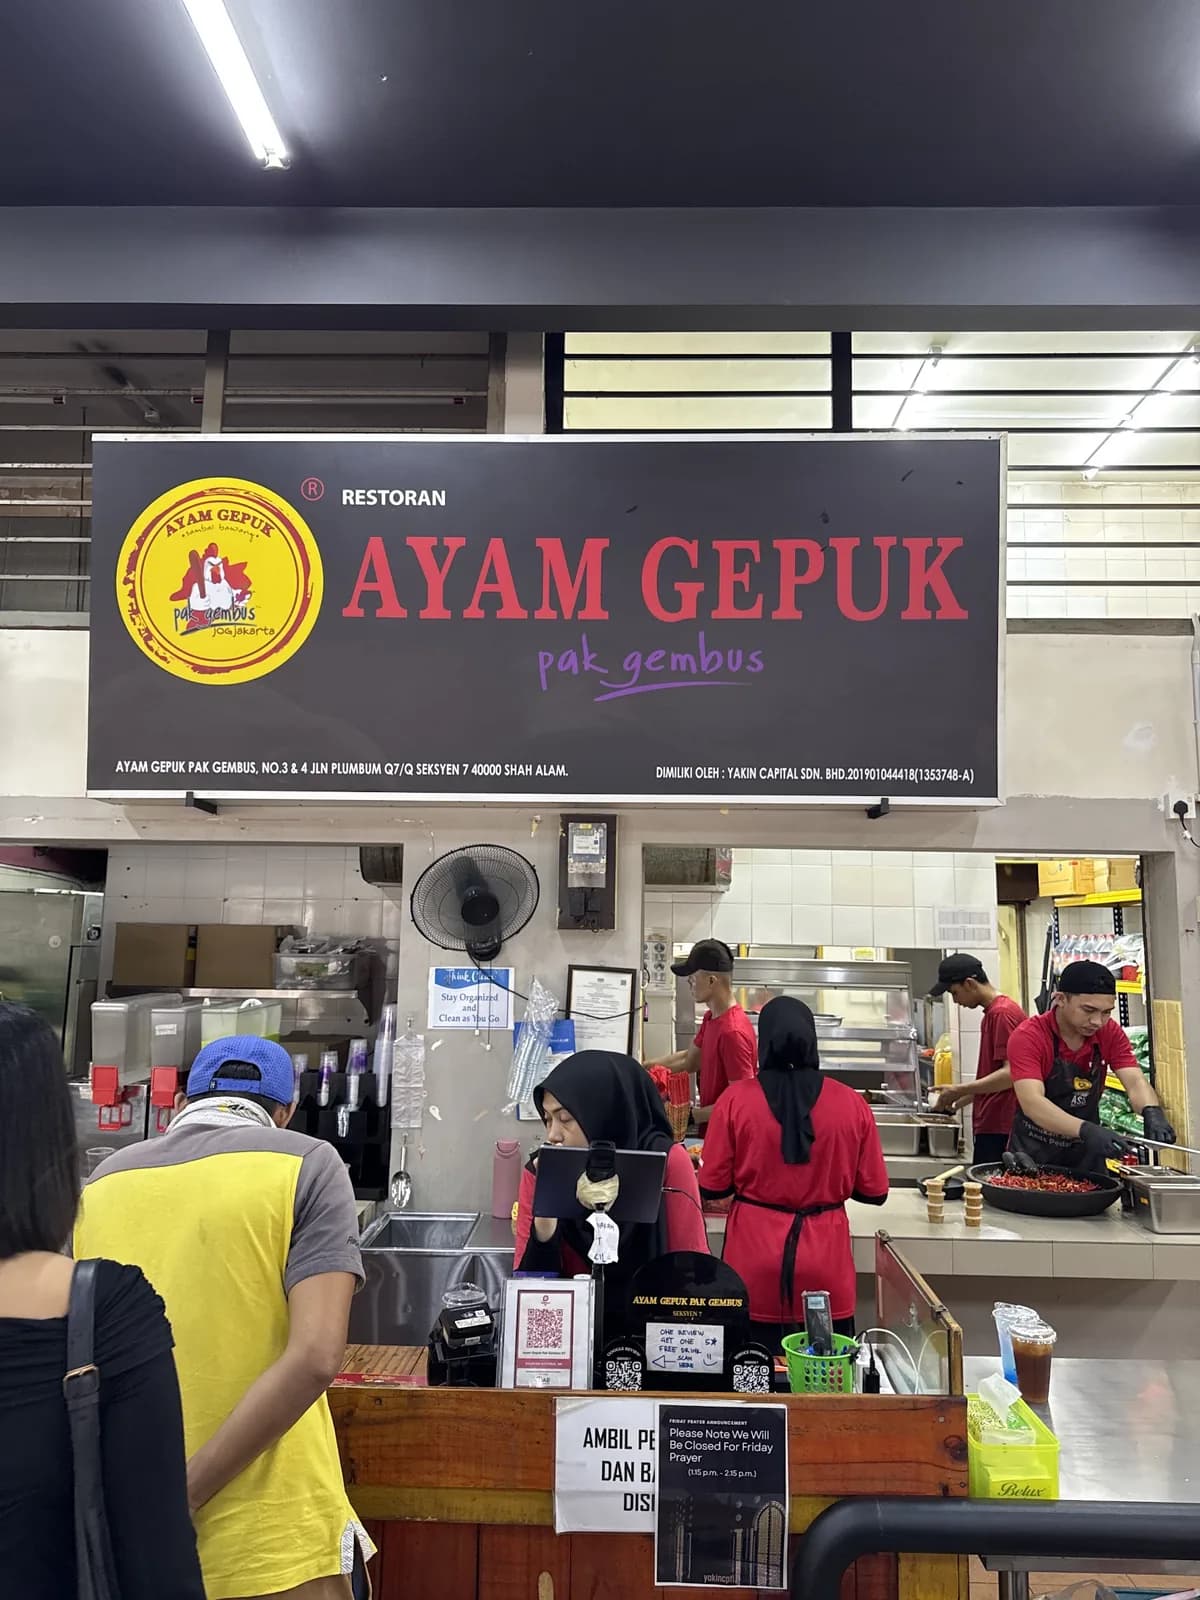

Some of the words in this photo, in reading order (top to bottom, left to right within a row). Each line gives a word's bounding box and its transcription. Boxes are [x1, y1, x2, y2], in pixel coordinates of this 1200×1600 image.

[342, 489, 447, 507] RESTORAN
[166, 510, 213, 537] AYAM
[217, 509, 275, 537] GEPUK
[342, 536, 610, 620] AYAM
[641, 536, 969, 622] GEPUK
[205, 596, 256, 625] gembus
[538, 633, 608, 690] pak
[600, 631, 764, 687] gembus
[115, 760, 148, 773] AYAM
[151, 760, 186, 773] GEPUK
[188, 761, 209, 774] PAK
[212, 761, 259, 776] GEMBUS,
[262, 762, 288, 775] NO.3
[291, 762, 298, 775] &
[301, 762, 308, 774] 4
[310, 762, 328, 775] JLN
[331, 762, 381, 776] PLUMBUM
[384, 763, 413, 776] Q7/Q
[416, 763, 460, 776] SEKSYEN
[462, 764, 469, 776] 7
[471, 764, 501, 776] 40000
[504, 764, 533, 777] SHAH
[535, 764, 569, 777] ALAM.
[656, 766, 693, 779] DIMILIKI
[695, 766, 719, 779] OLEH
[727, 767, 757, 779] YAKIN
[759, 767, 798, 780] CAPITAL
[800, 768, 823, 780] SDN.
[441, 993, 458, 1004] Stay
[460, 993, 498, 1003] Organized
[462, 1004, 477, 1012] and
[439, 1014, 461, 1023] Clean
[462, 1015, 471, 1023] as
[472, 1014, 487, 1023] You
[489, 1014, 500, 1023] Go
[632, 1295, 658, 1305] AYAM
[660, 1296, 688, 1306] GEPUK
[689, 1297, 706, 1306] PAK
[708, 1298, 743, 1307] GEMBUS
[678, 1329, 705, 1337] REVIEW
[659, 1345, 679, 1353] FREE
[583, 1427, 632, 1449] AMBIL
[670, 1428, 703, 1438] Please
[705, 1429, 730, 1439] Note
[732, 1430, 749, 1440] We
[751, 1430, 770, 1440] Will
[670, 1440, 683, 1450] Be
[684, 1441, 721, 1451] Closed
[723, 1442, 739, 1451] For
[742, 1442, 774, 1454] Friday
[669, 1452, 702, 1464] Prayer
[601, 1460, 635, 1482] DAN
[739, 1470, 757, 1478] p.m.)
